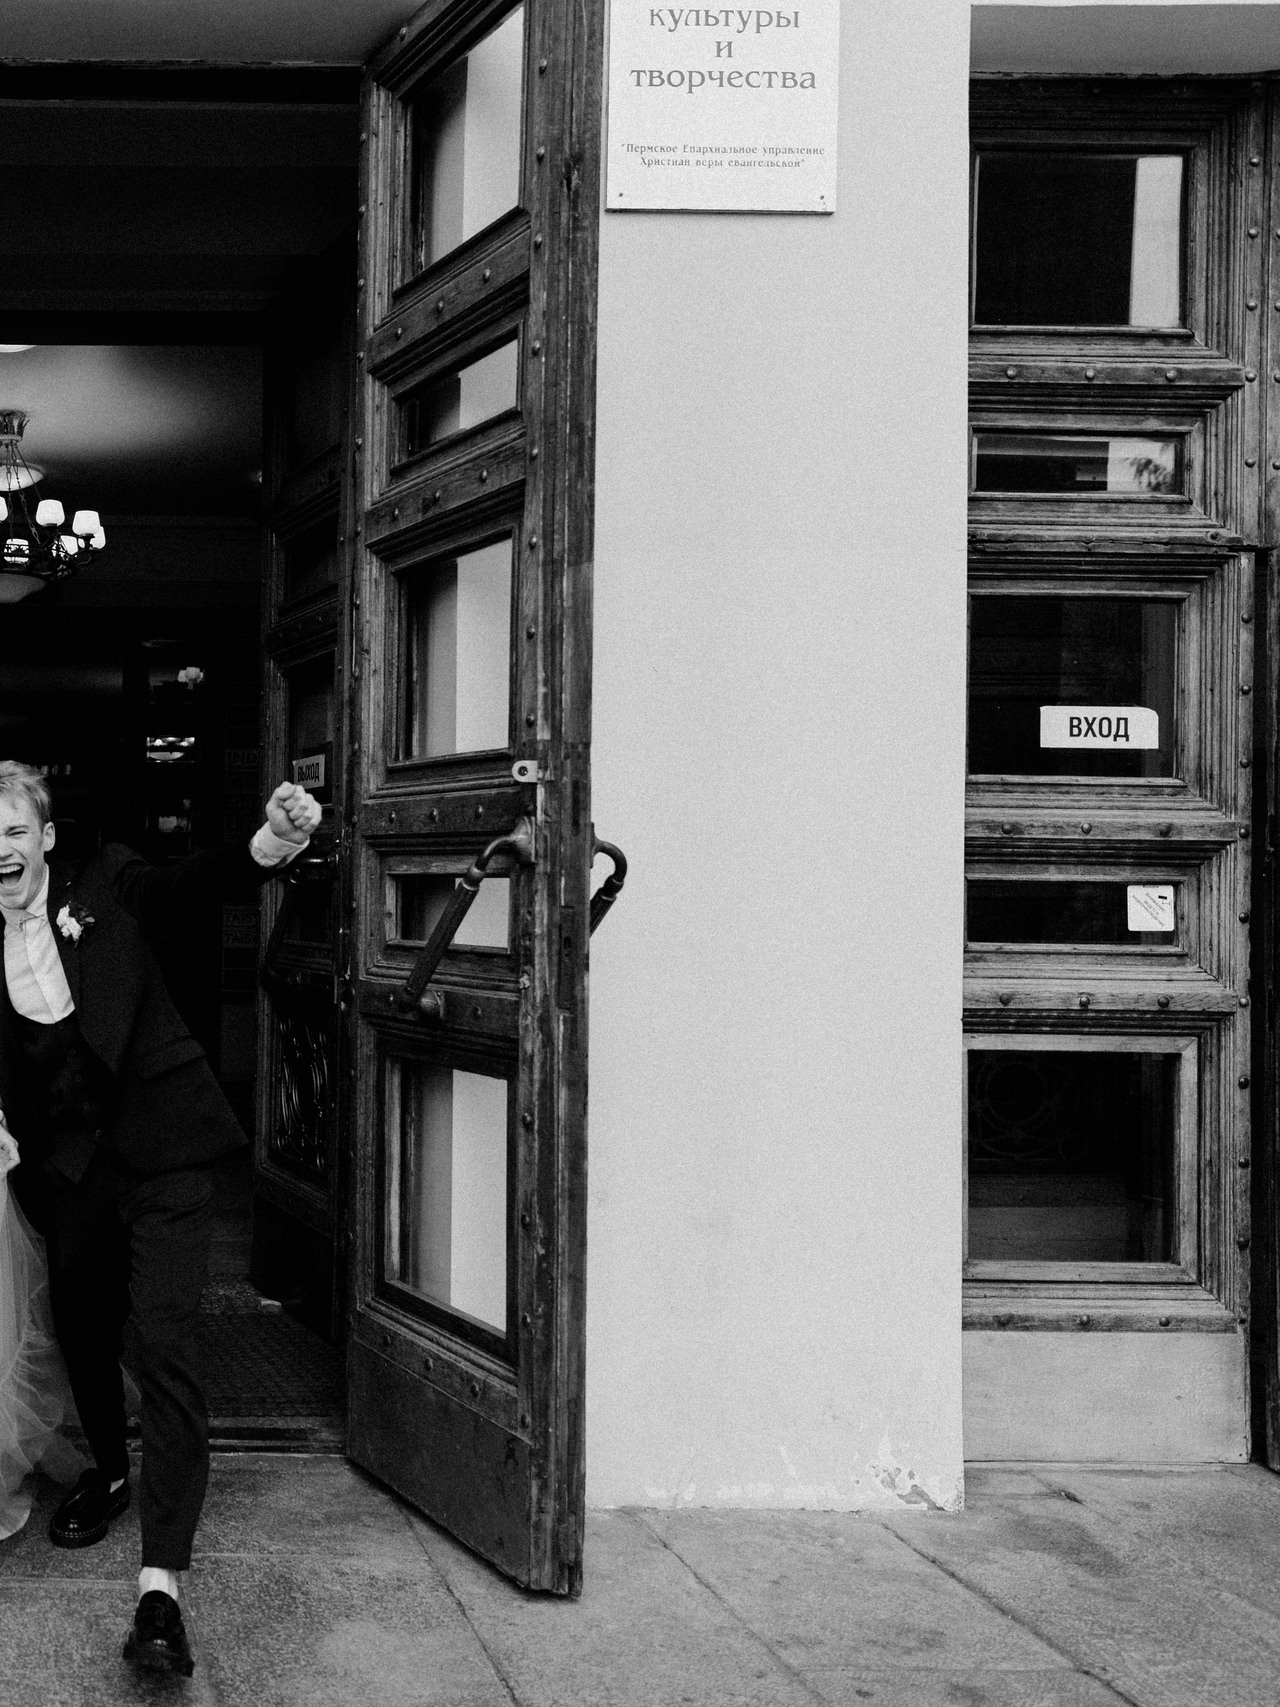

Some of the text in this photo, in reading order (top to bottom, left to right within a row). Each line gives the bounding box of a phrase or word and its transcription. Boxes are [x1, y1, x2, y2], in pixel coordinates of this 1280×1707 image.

[649, 9, 799, 34] культуры
[715, 40, 733, 58] и
[630, 69, 816, 94] творчества
[683, 144, 758, 156] Епархиальное
[762, 146, 825, 157] управление
[640, 156, 690, 168] Христиан
[695, 158, 723, 169] веры
[1069, 716, 1130, 742] ВХОД
[297, 762, 320, 783] ВЫХОД
